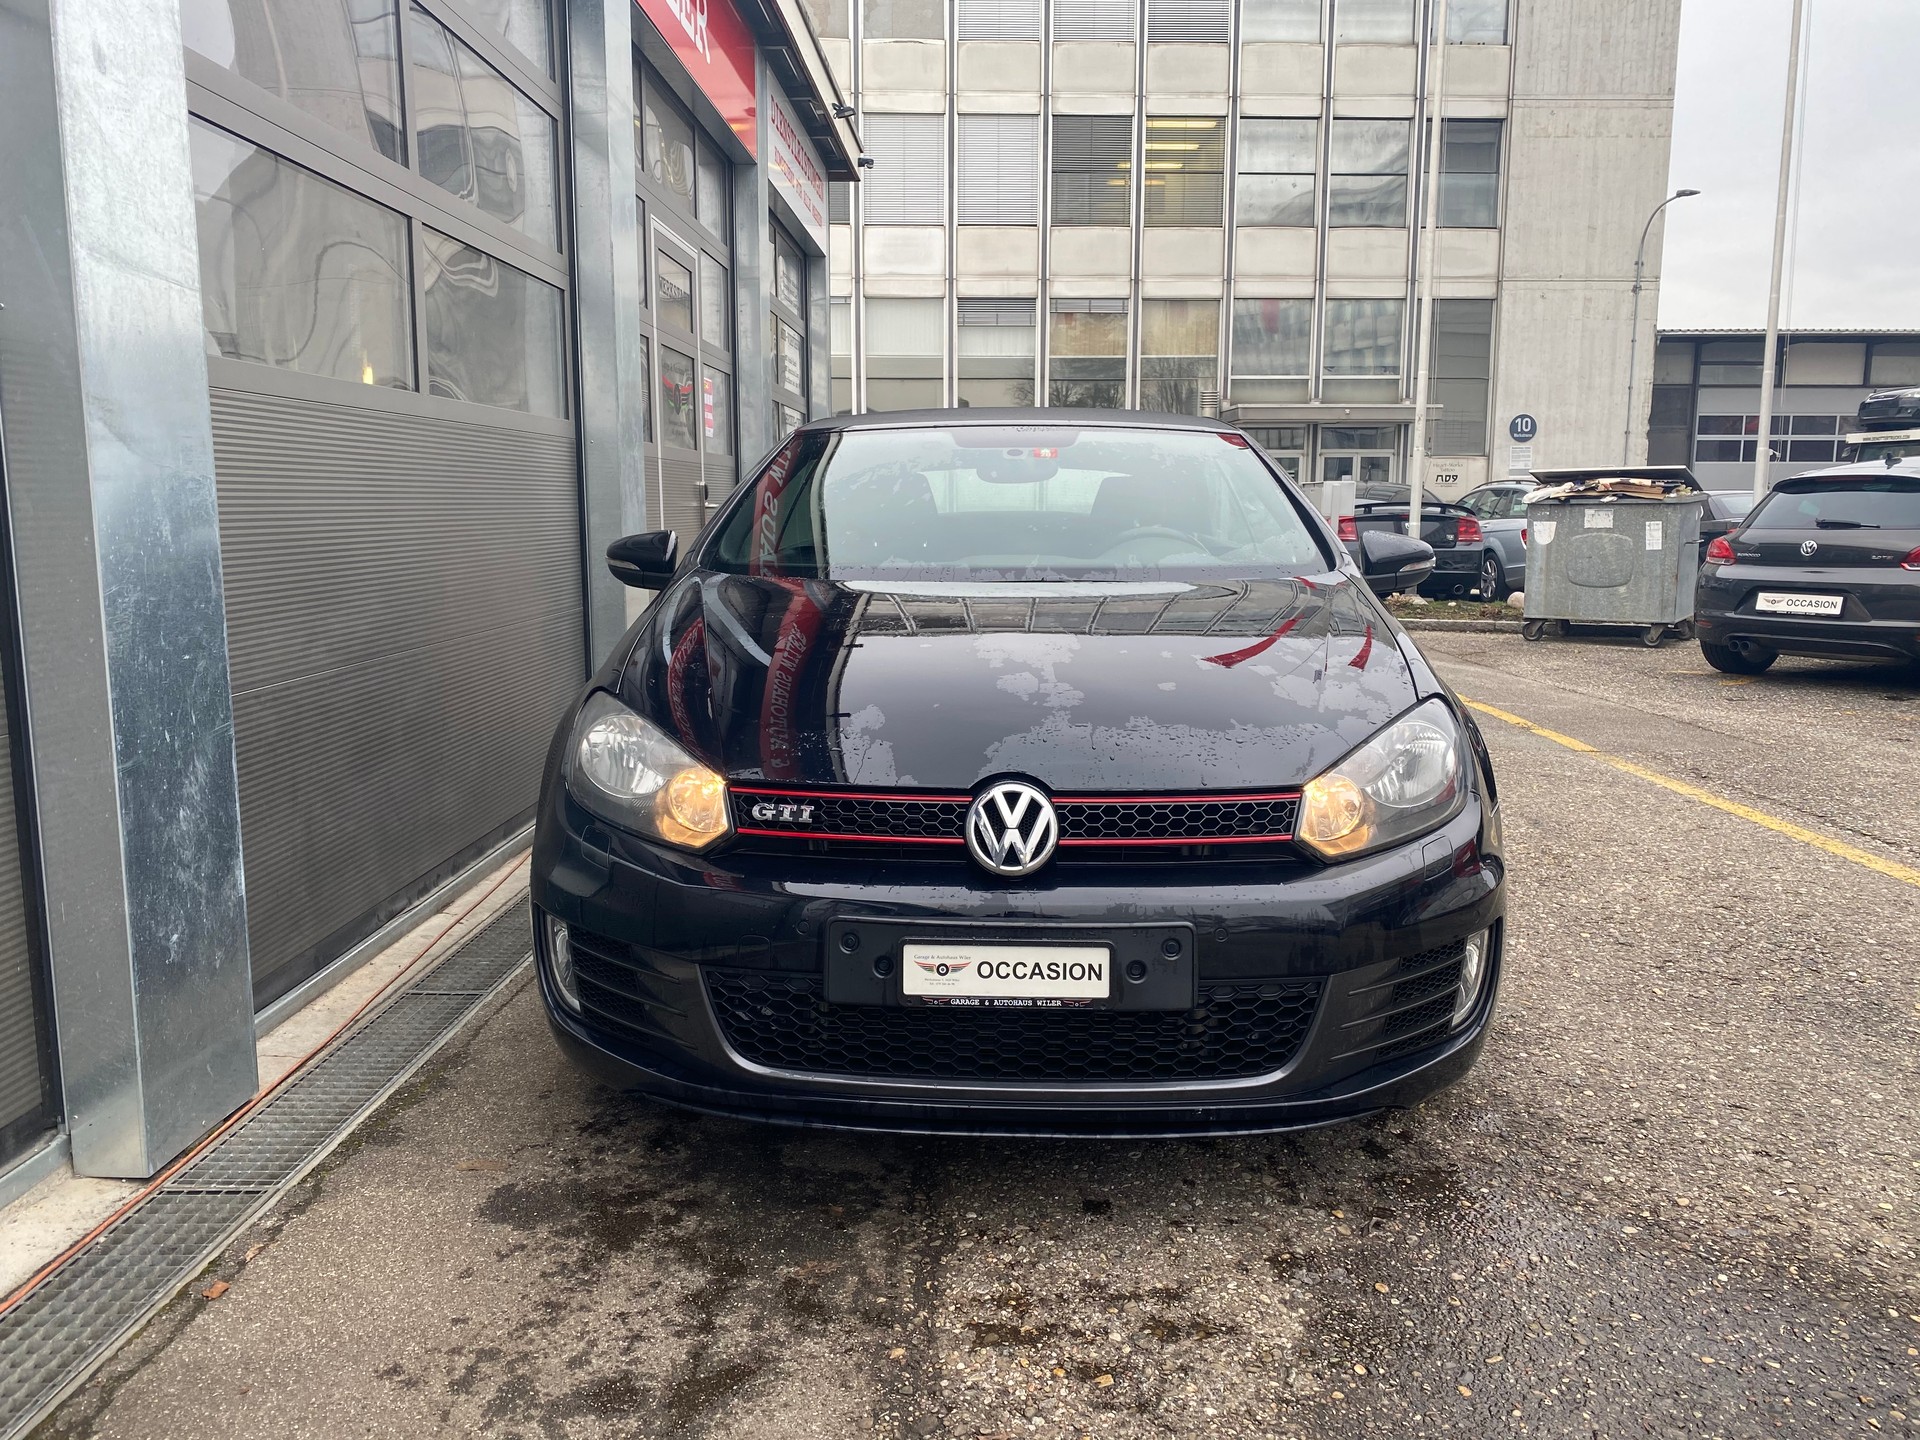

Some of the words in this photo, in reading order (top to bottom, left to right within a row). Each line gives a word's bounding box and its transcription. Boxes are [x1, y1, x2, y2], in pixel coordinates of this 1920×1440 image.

[1515, 417, 1531, 432] 10
[1786, 598, 1838, 609] OCCASION
[752, 803, 815, 824] GTI
[970, 786, 1055, 872] VW
[977, 960, 1102, 981] OCCASION
[950, 998, 980, 1006] GARAGE
[1037, 999, 1062, 1007] WILER
